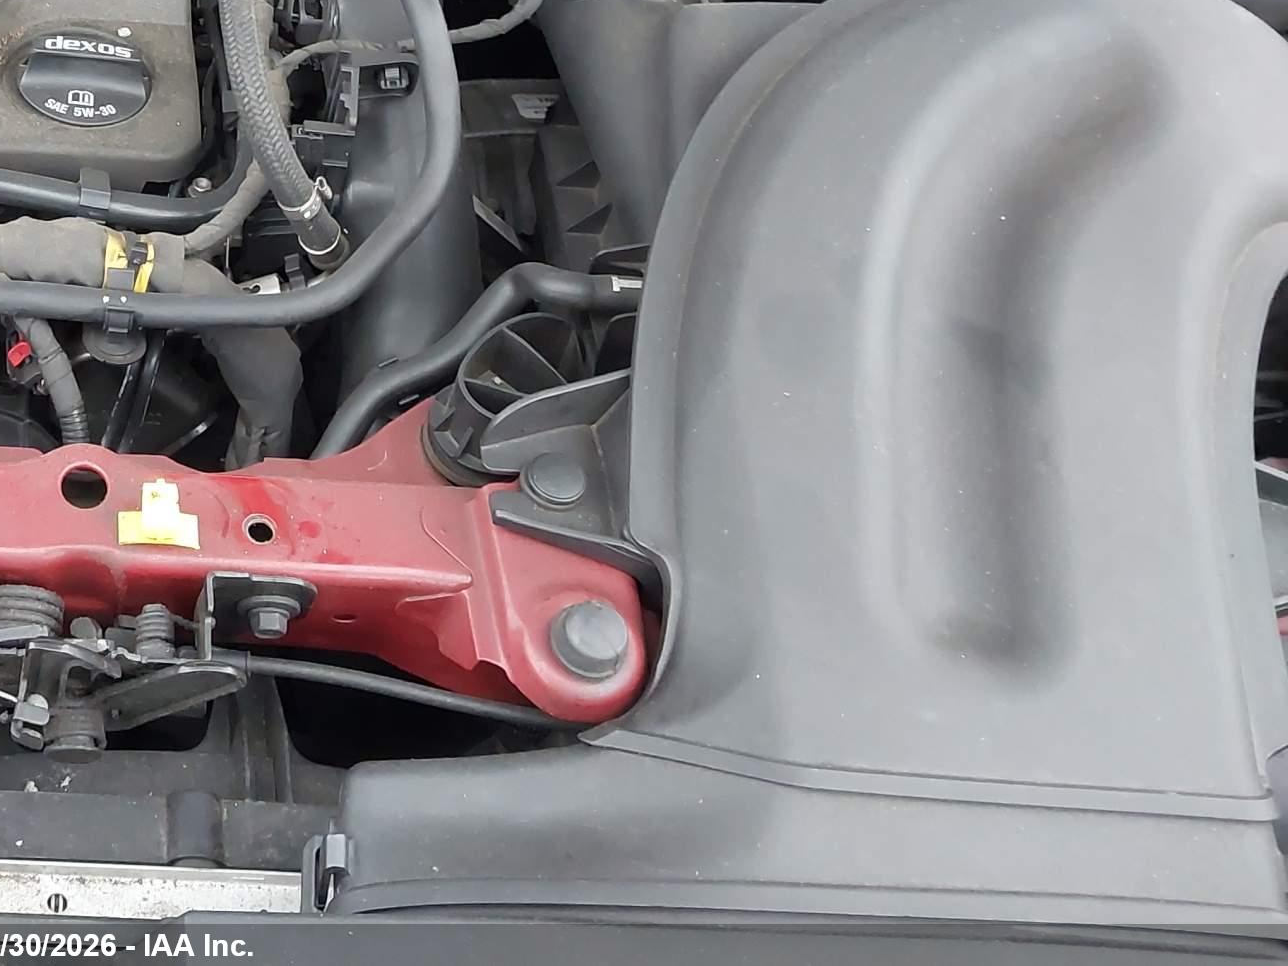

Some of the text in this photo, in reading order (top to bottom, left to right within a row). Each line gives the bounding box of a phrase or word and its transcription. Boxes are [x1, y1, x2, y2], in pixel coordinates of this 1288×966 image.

[45, 36, 134, 59] dexos
[44, 98, 117, 118] SAE 5W-30
